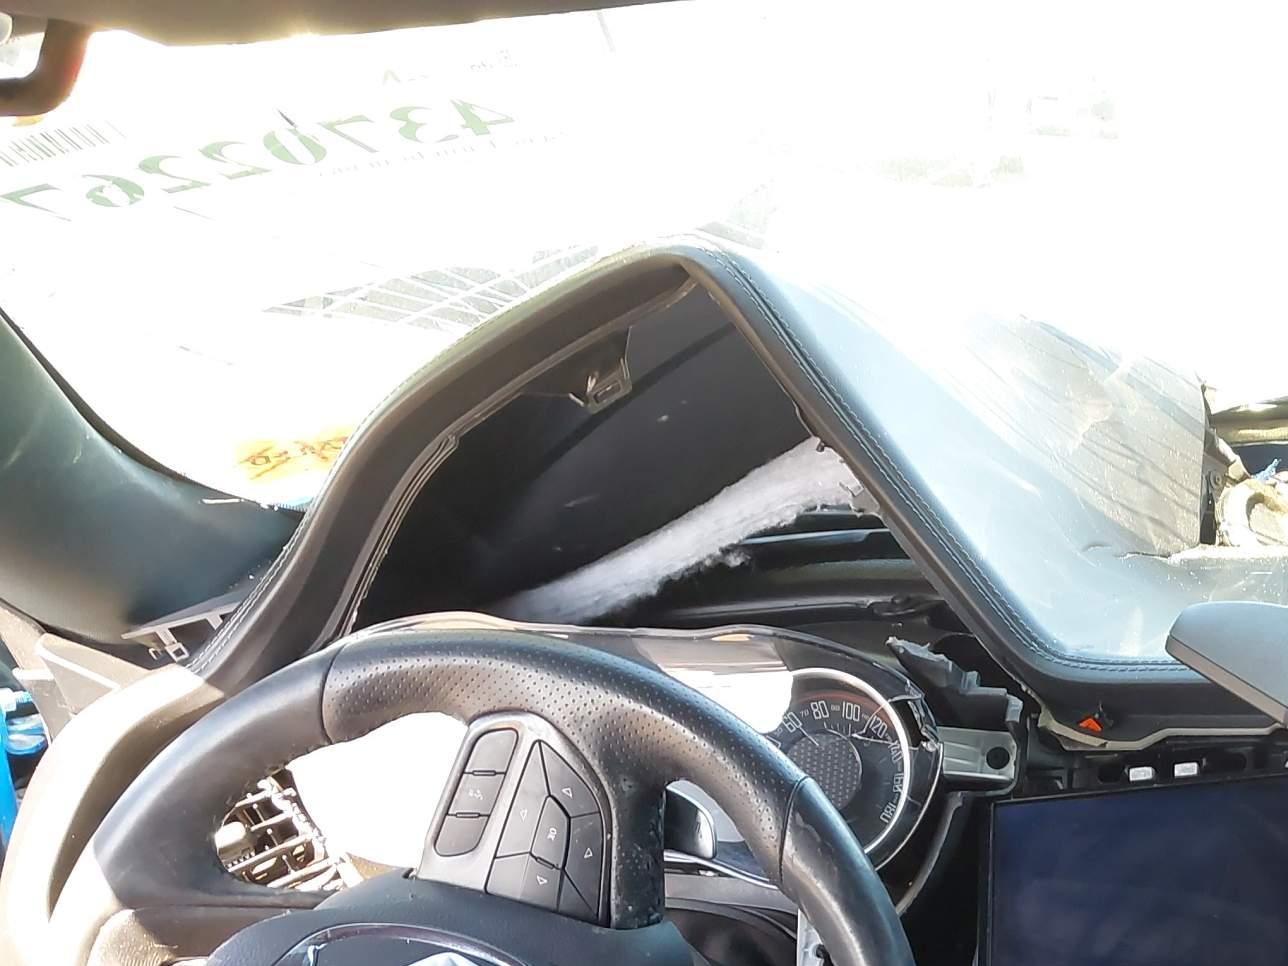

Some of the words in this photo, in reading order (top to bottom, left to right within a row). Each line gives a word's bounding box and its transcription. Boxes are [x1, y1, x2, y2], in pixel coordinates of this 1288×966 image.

[810, 700, 829, 719] 80
[842, 701, 860, 722] 100
[783, 711, 802, 733] 60
[869, 714, 888, 739] 120
